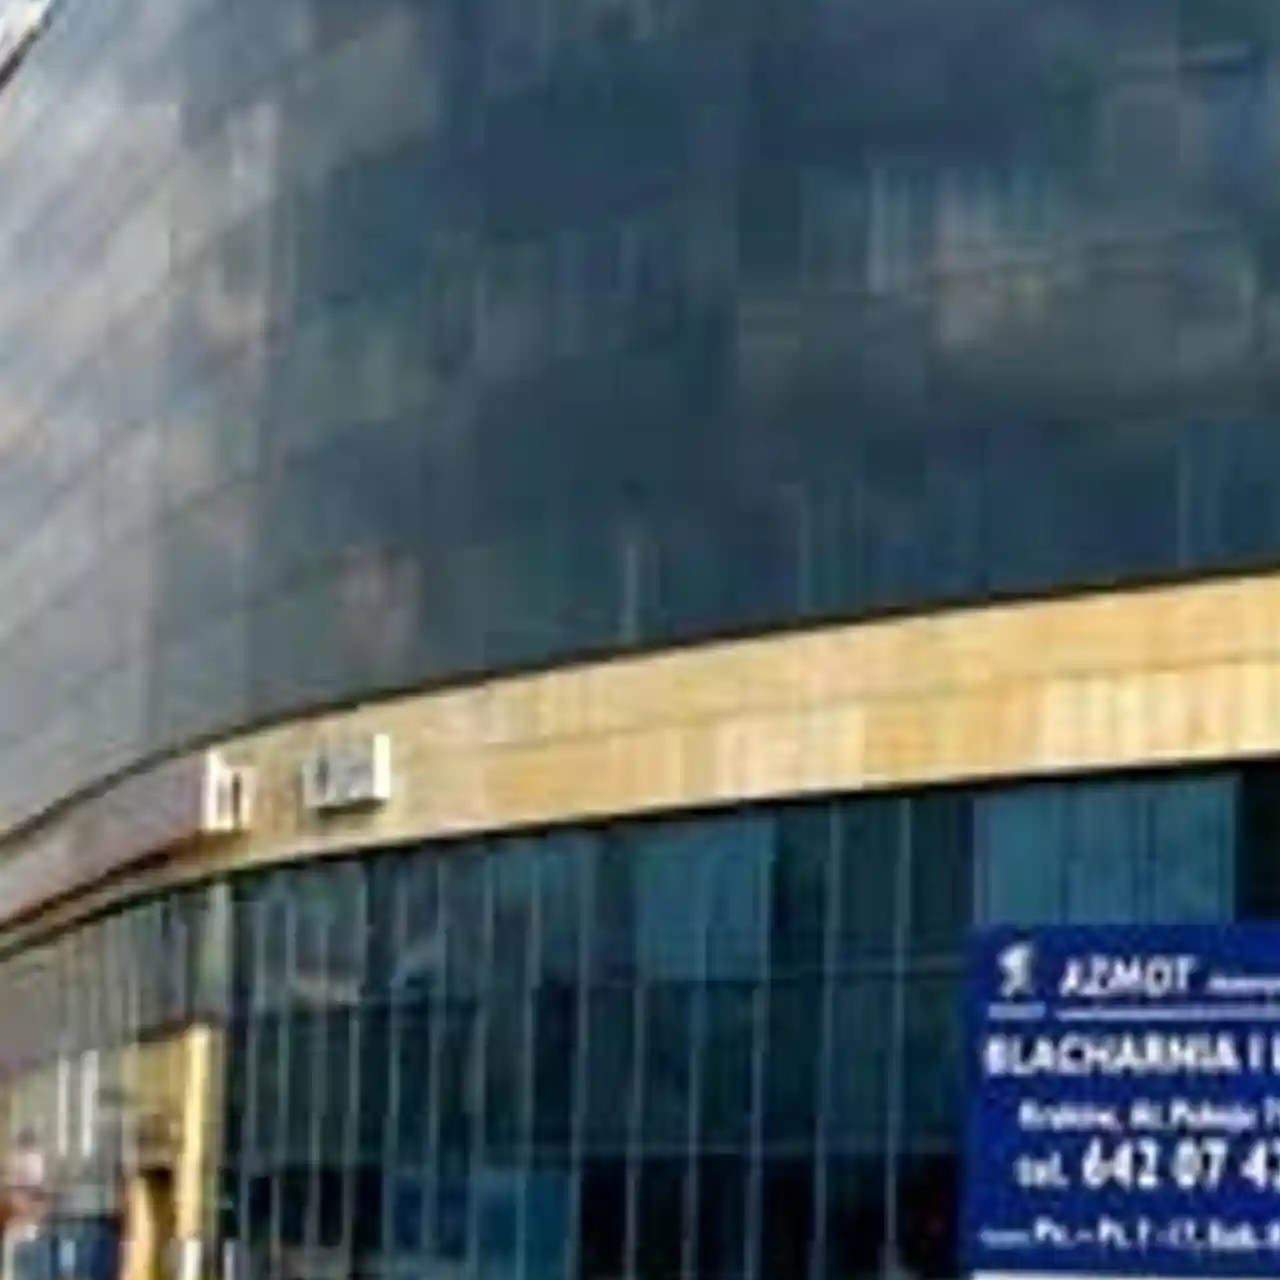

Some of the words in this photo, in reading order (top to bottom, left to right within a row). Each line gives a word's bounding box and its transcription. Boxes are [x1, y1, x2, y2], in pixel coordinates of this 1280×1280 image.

[984, 1030, 1240, 1078] BLACHARNIA
[1249, 1032, 1263, 1072] I
[1081, 1136, 1161, 1192] 642
[1170, 1136, 1227, 1192] 07
